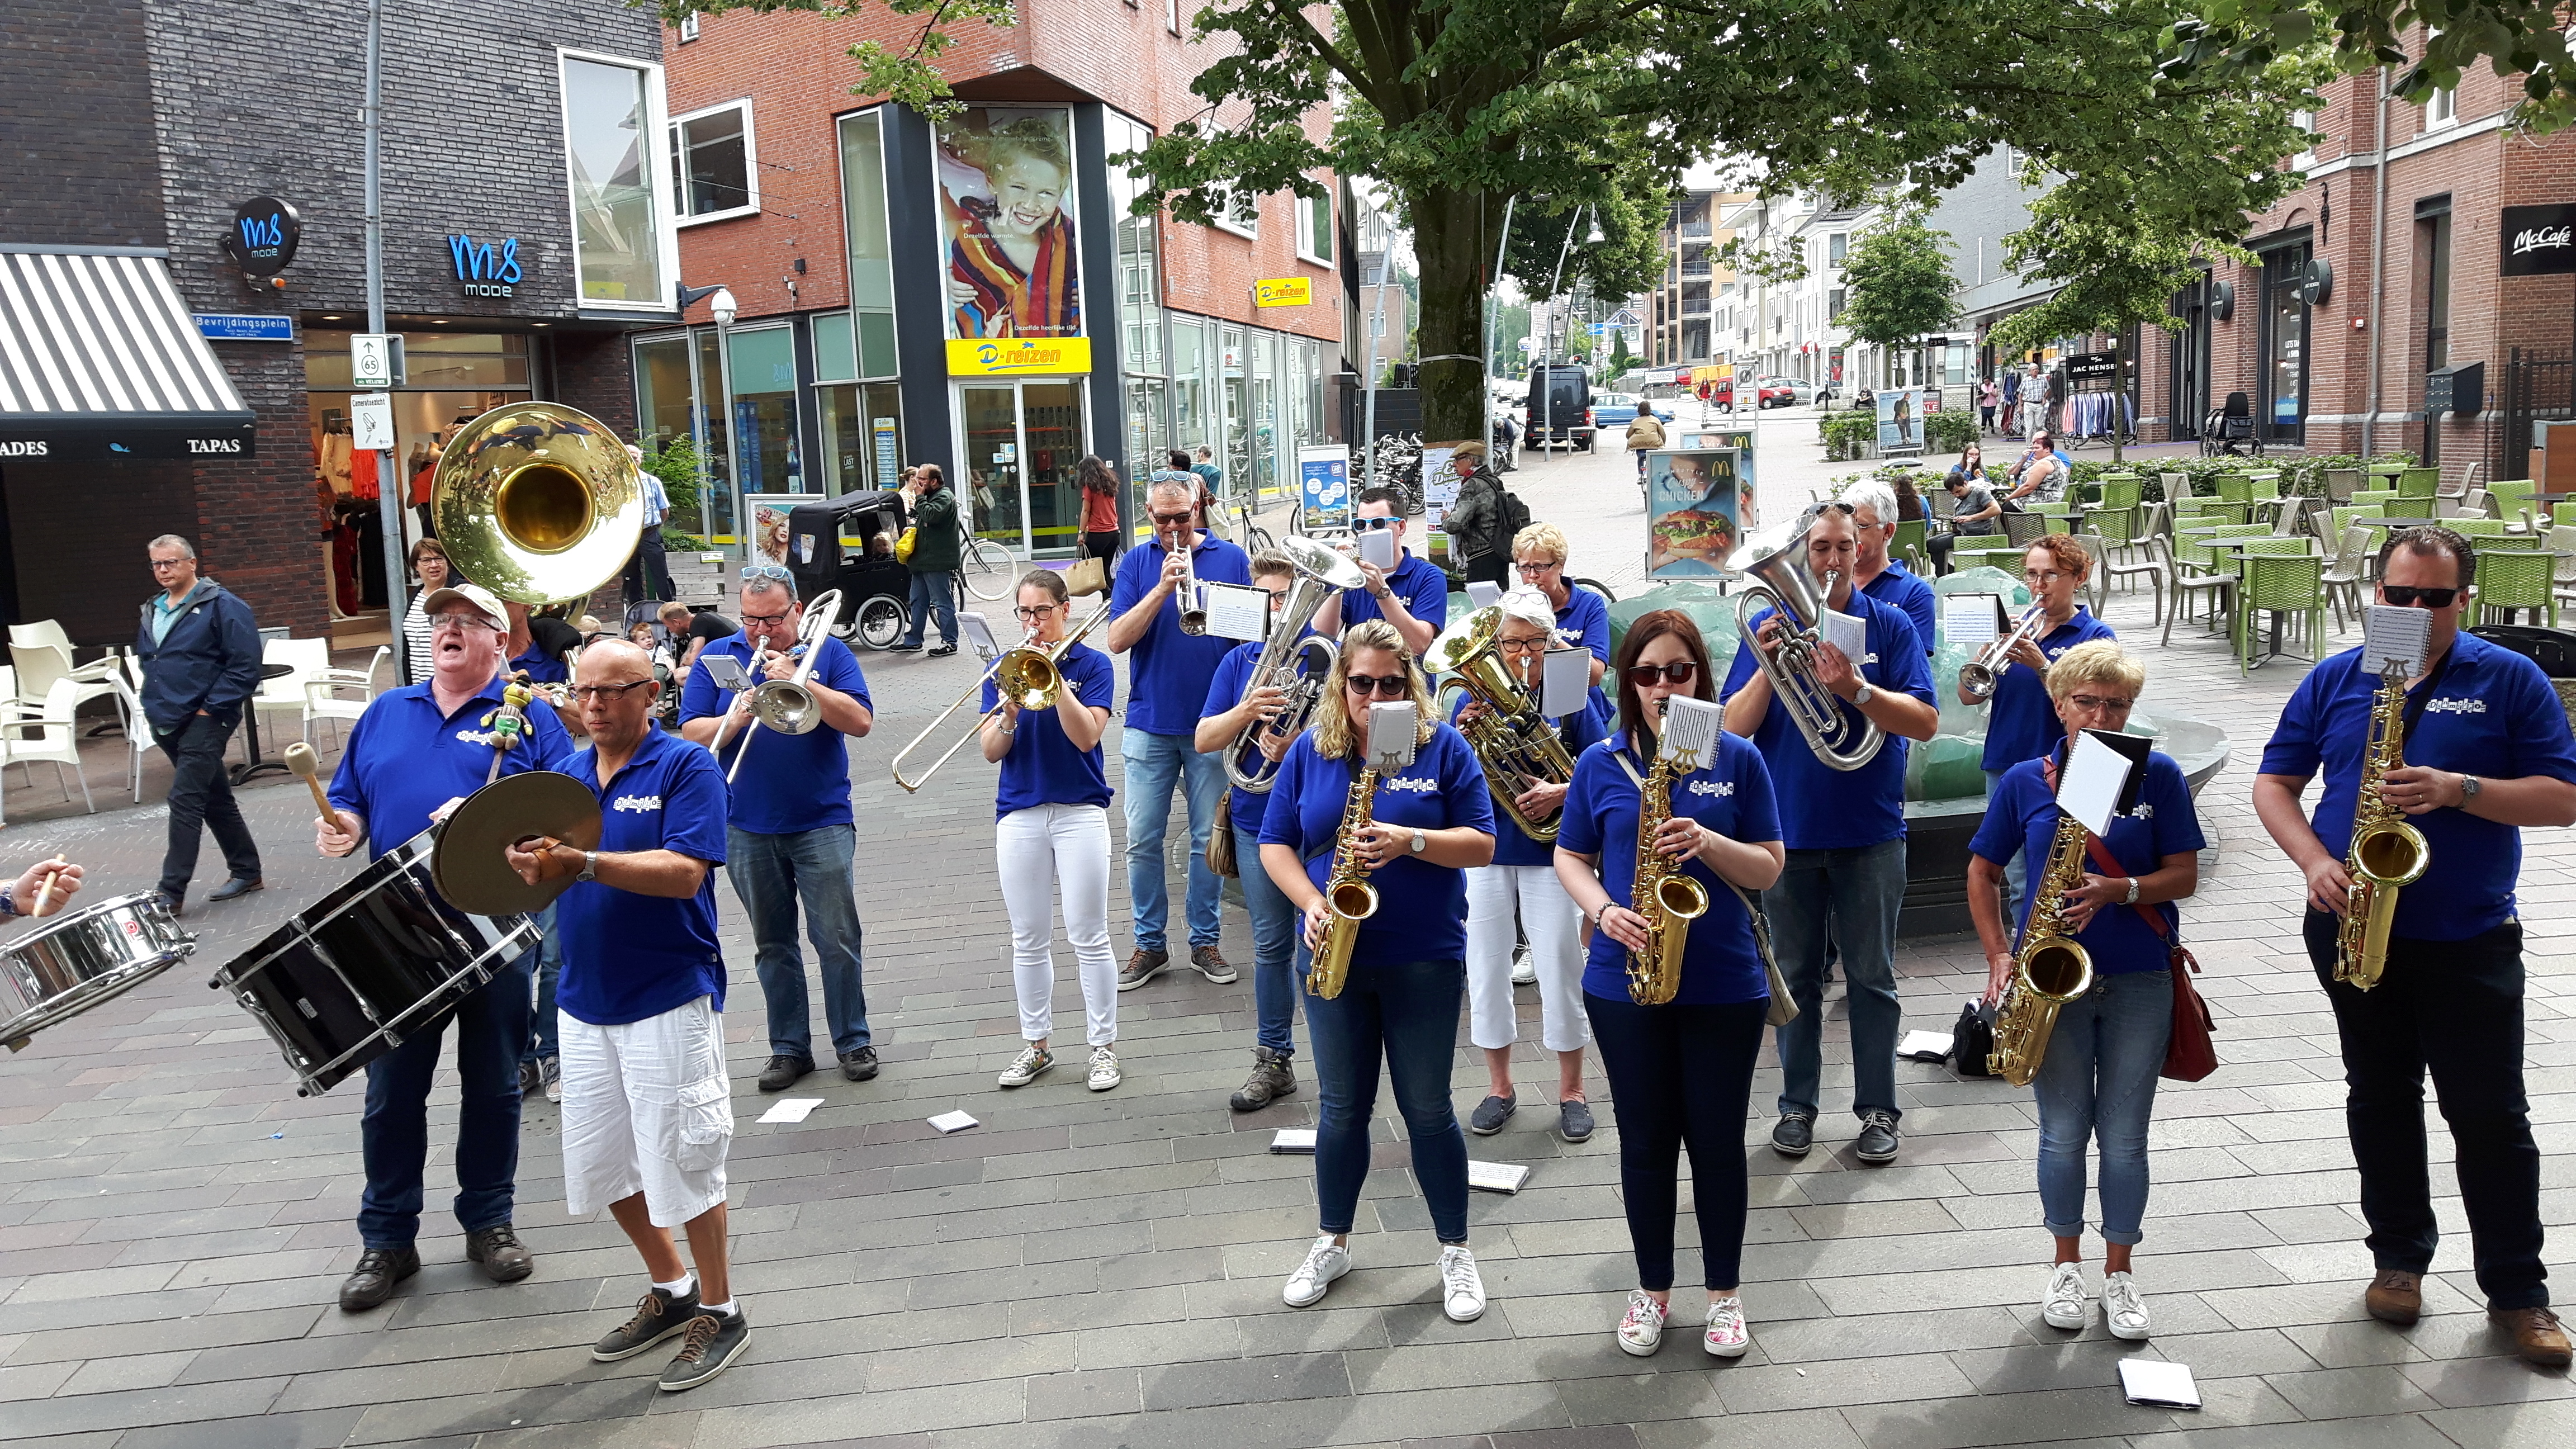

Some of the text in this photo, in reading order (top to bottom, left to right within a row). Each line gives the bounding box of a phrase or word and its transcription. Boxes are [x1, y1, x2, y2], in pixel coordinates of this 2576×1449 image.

[2513, 226, 2572, 252] McCafé
[1260, 283, 1305, 297] D-reizen
[196, 317, 286, 329] Bevrijdingsplein
[977, 342, 1061, 364] D-reizen
[364, 360, 376, 370] 65
[352, 397, 385, 407] Cameratoezicht
[187, 439, 241, 453] TAPAS
[1659, 490, 1704, 501] CHICKEN
